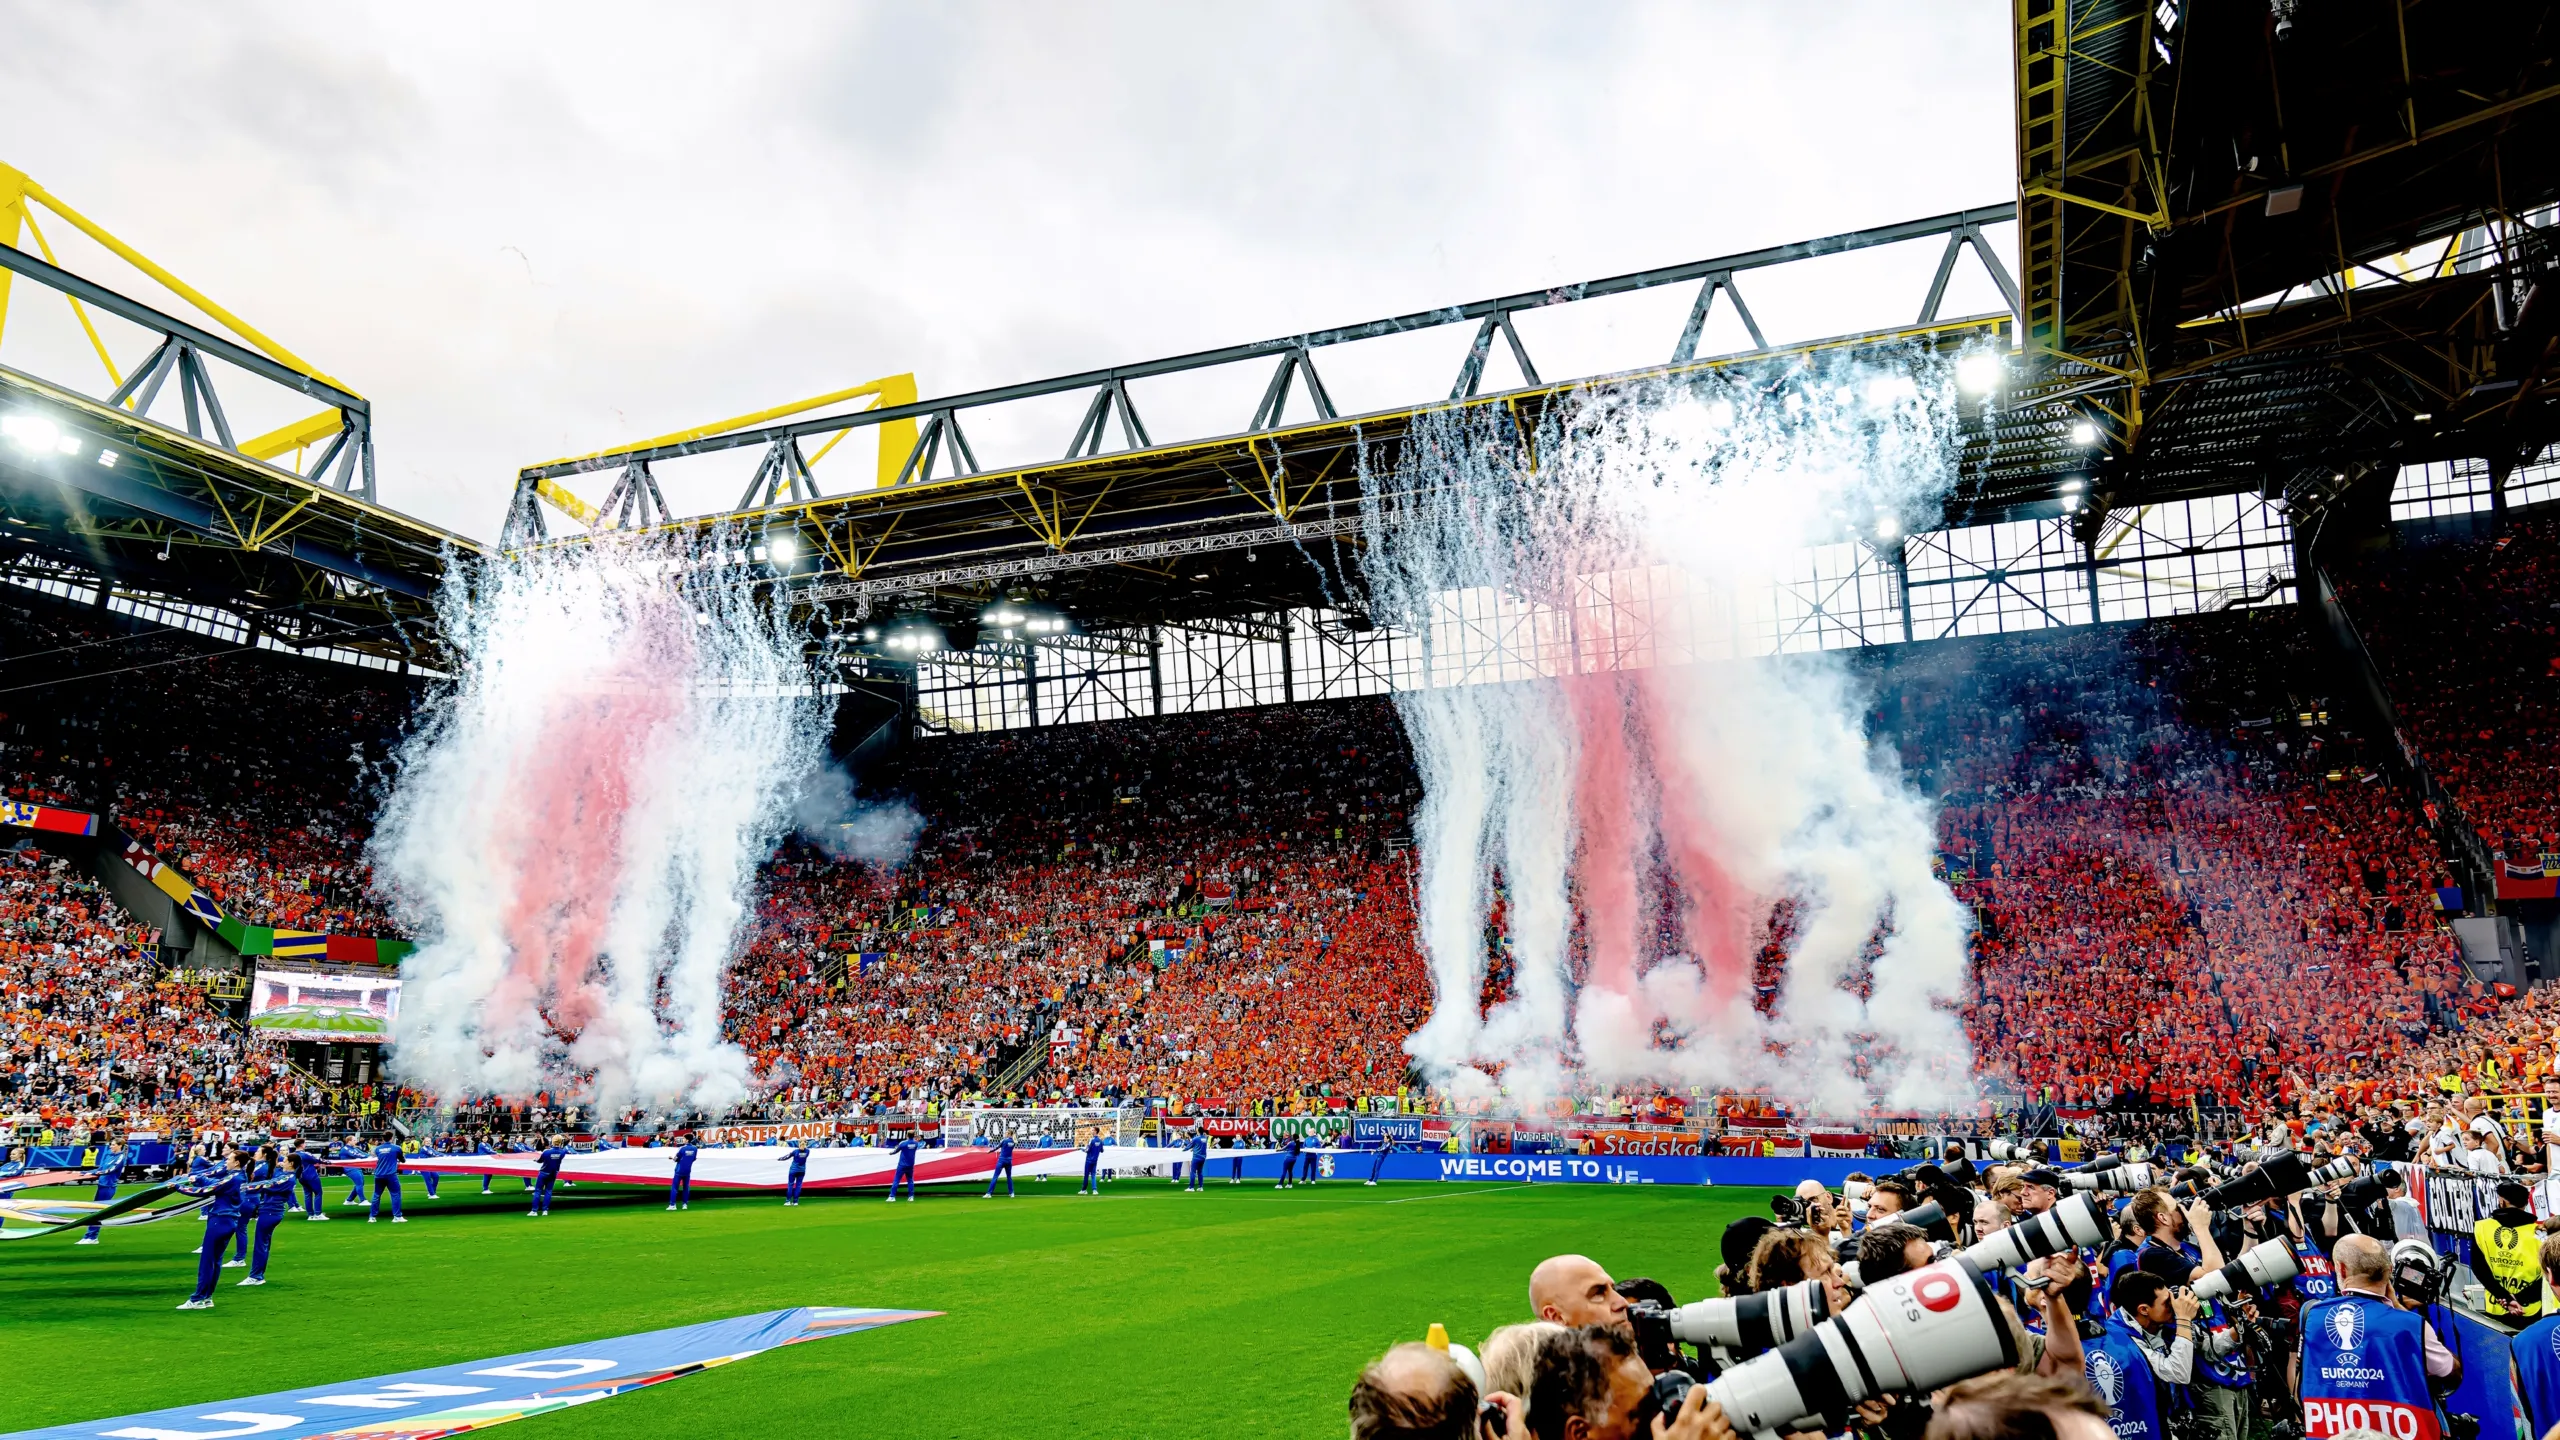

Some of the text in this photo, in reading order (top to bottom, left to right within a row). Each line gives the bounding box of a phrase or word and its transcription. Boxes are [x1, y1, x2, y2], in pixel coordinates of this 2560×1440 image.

[1207, 1119, 1267, 1131] ADMIX
[1359, 1123, 1417, 1140] Velswijk
[1516, 1131, 1552, 1141] VORDEN
[1440, 1159, 1563, 1177] WELCOME
[1568, 1160, 1600, 1177] TO
[2337, 1353, 2360, 1366] UEFA
[2321, 1367, 2384, 1380] EURO2024
[2336, 1381, 2369, 1389] GERMANY
[2303, 1401, 2418, 1440] PHOTO
